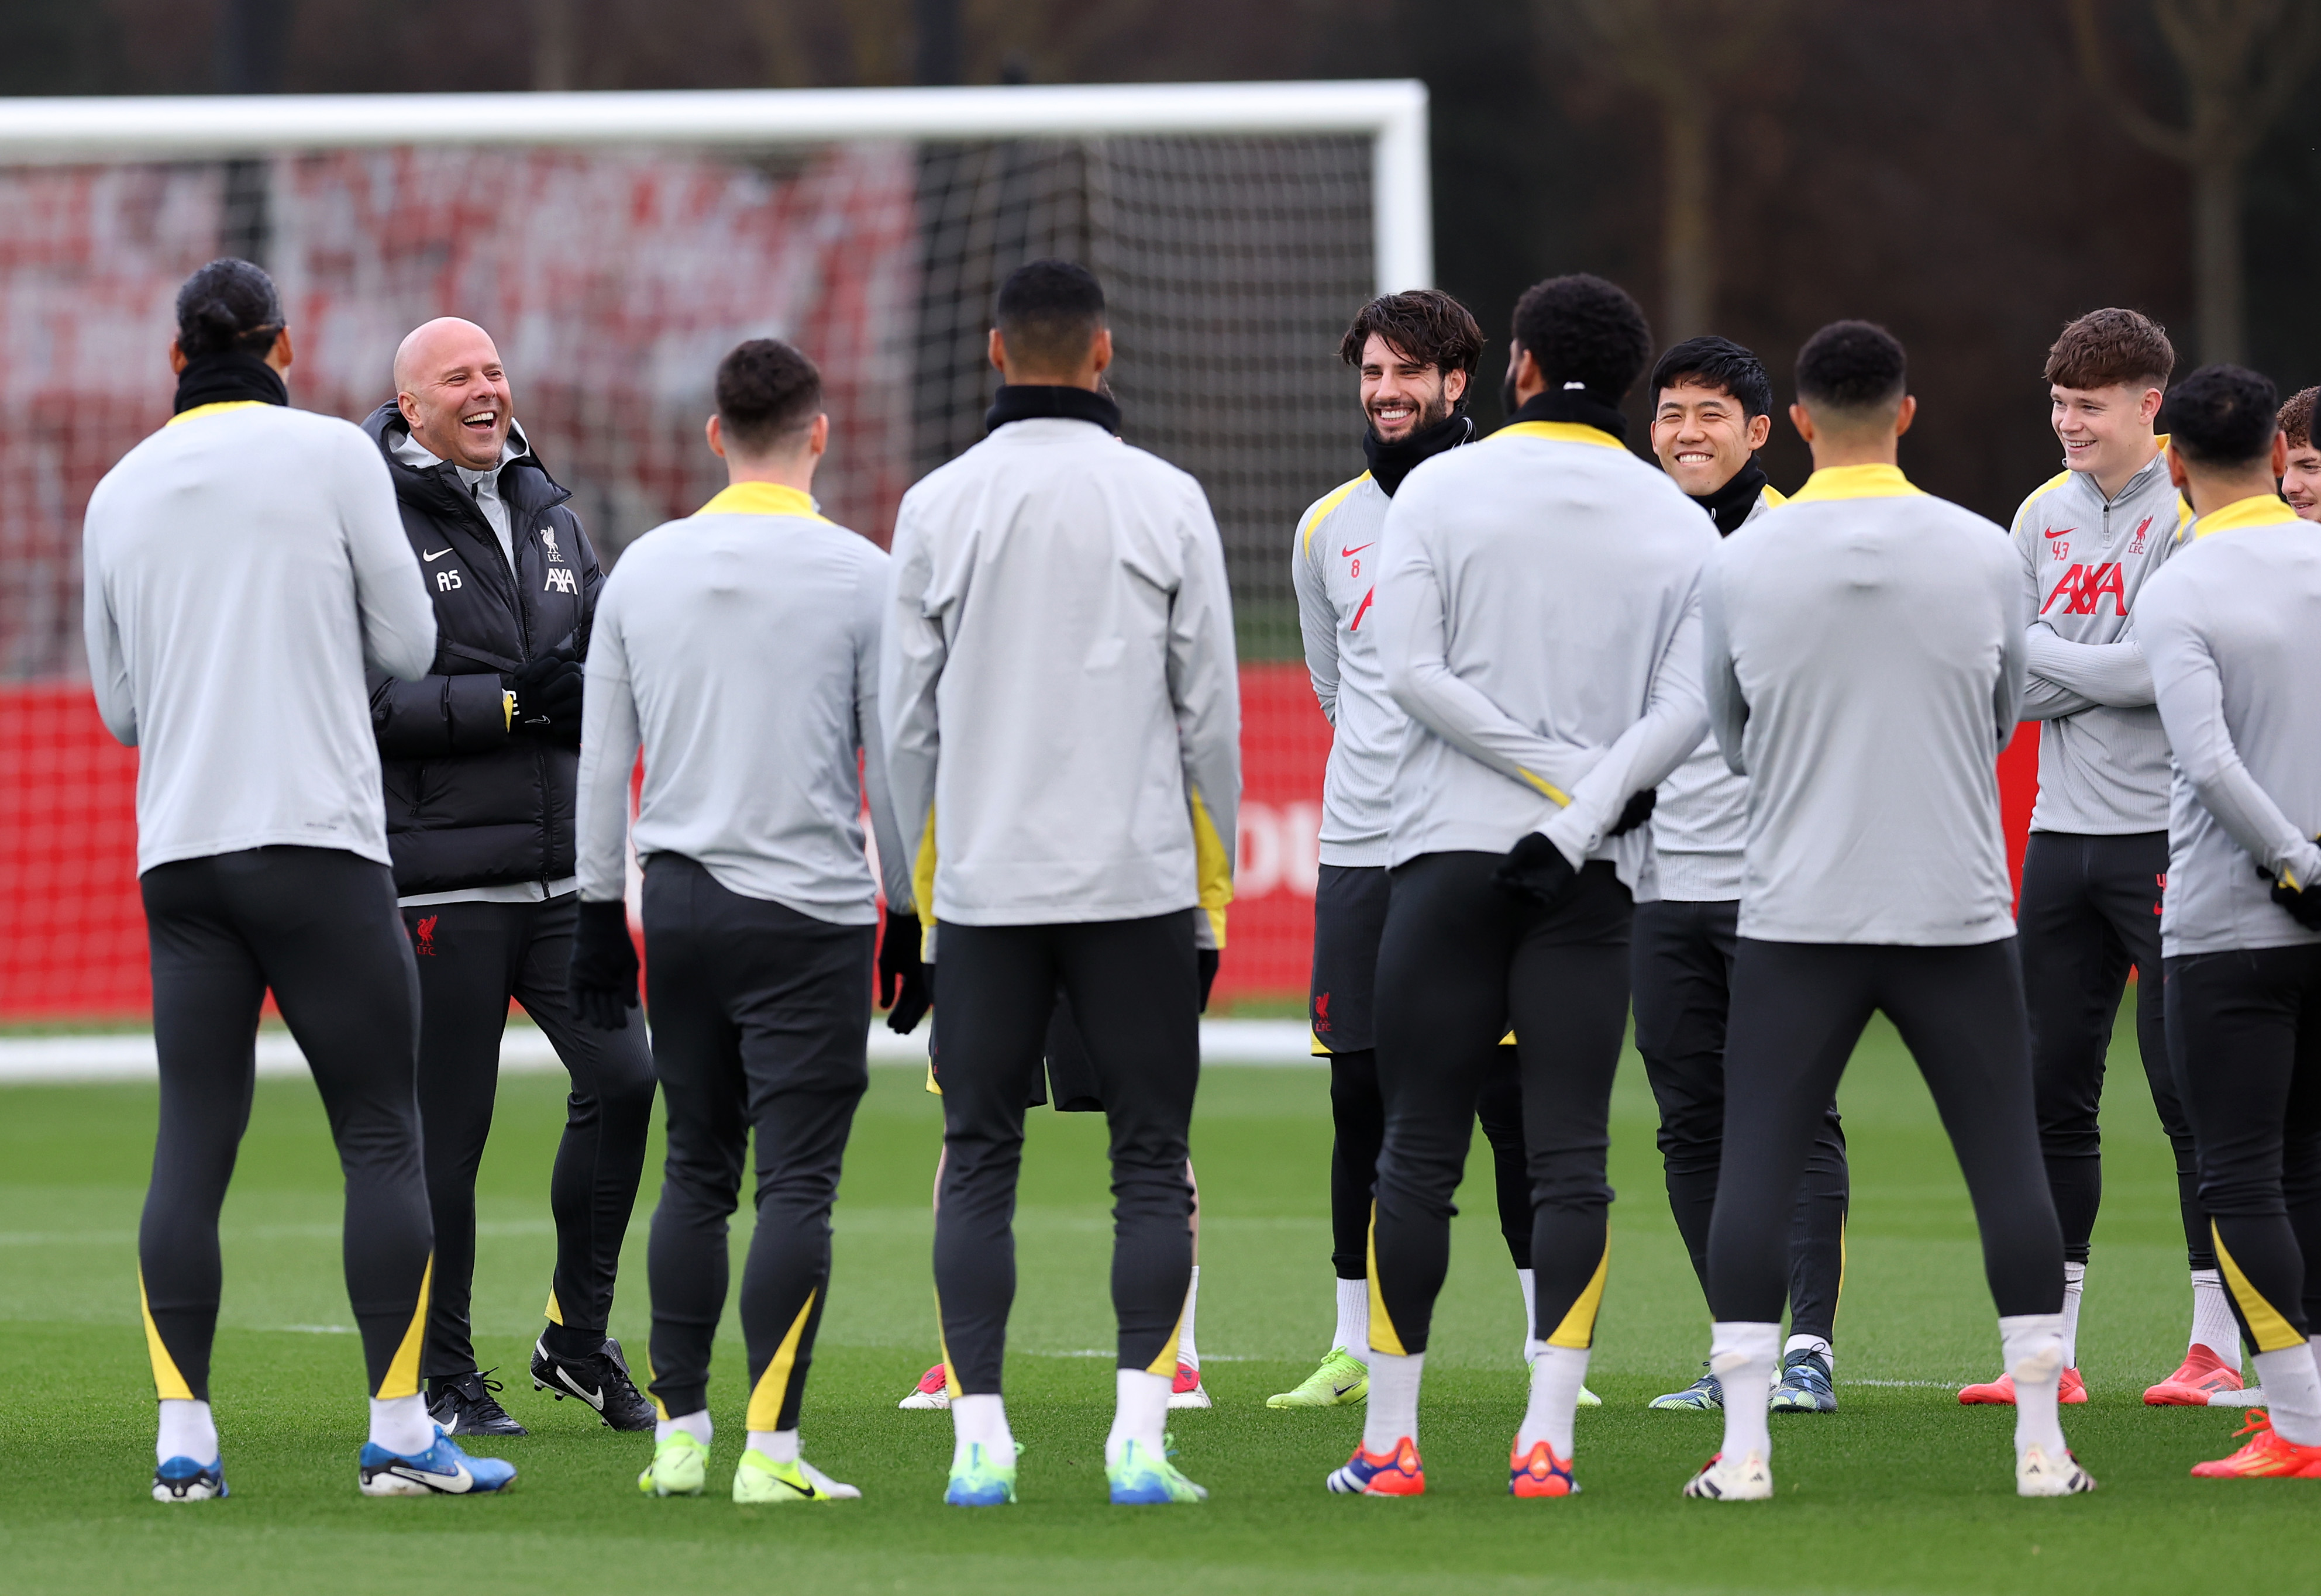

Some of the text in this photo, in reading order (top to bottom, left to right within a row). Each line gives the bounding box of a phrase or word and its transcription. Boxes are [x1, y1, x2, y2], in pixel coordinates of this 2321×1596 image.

[2052, 541, 2069, 561] 43
[1351, 559, 1360, 578] 8
[436, 570, 462, 592] AS
[544, 568, 578, 595] AXA
[2040, 562, 2128, 616] AXA
